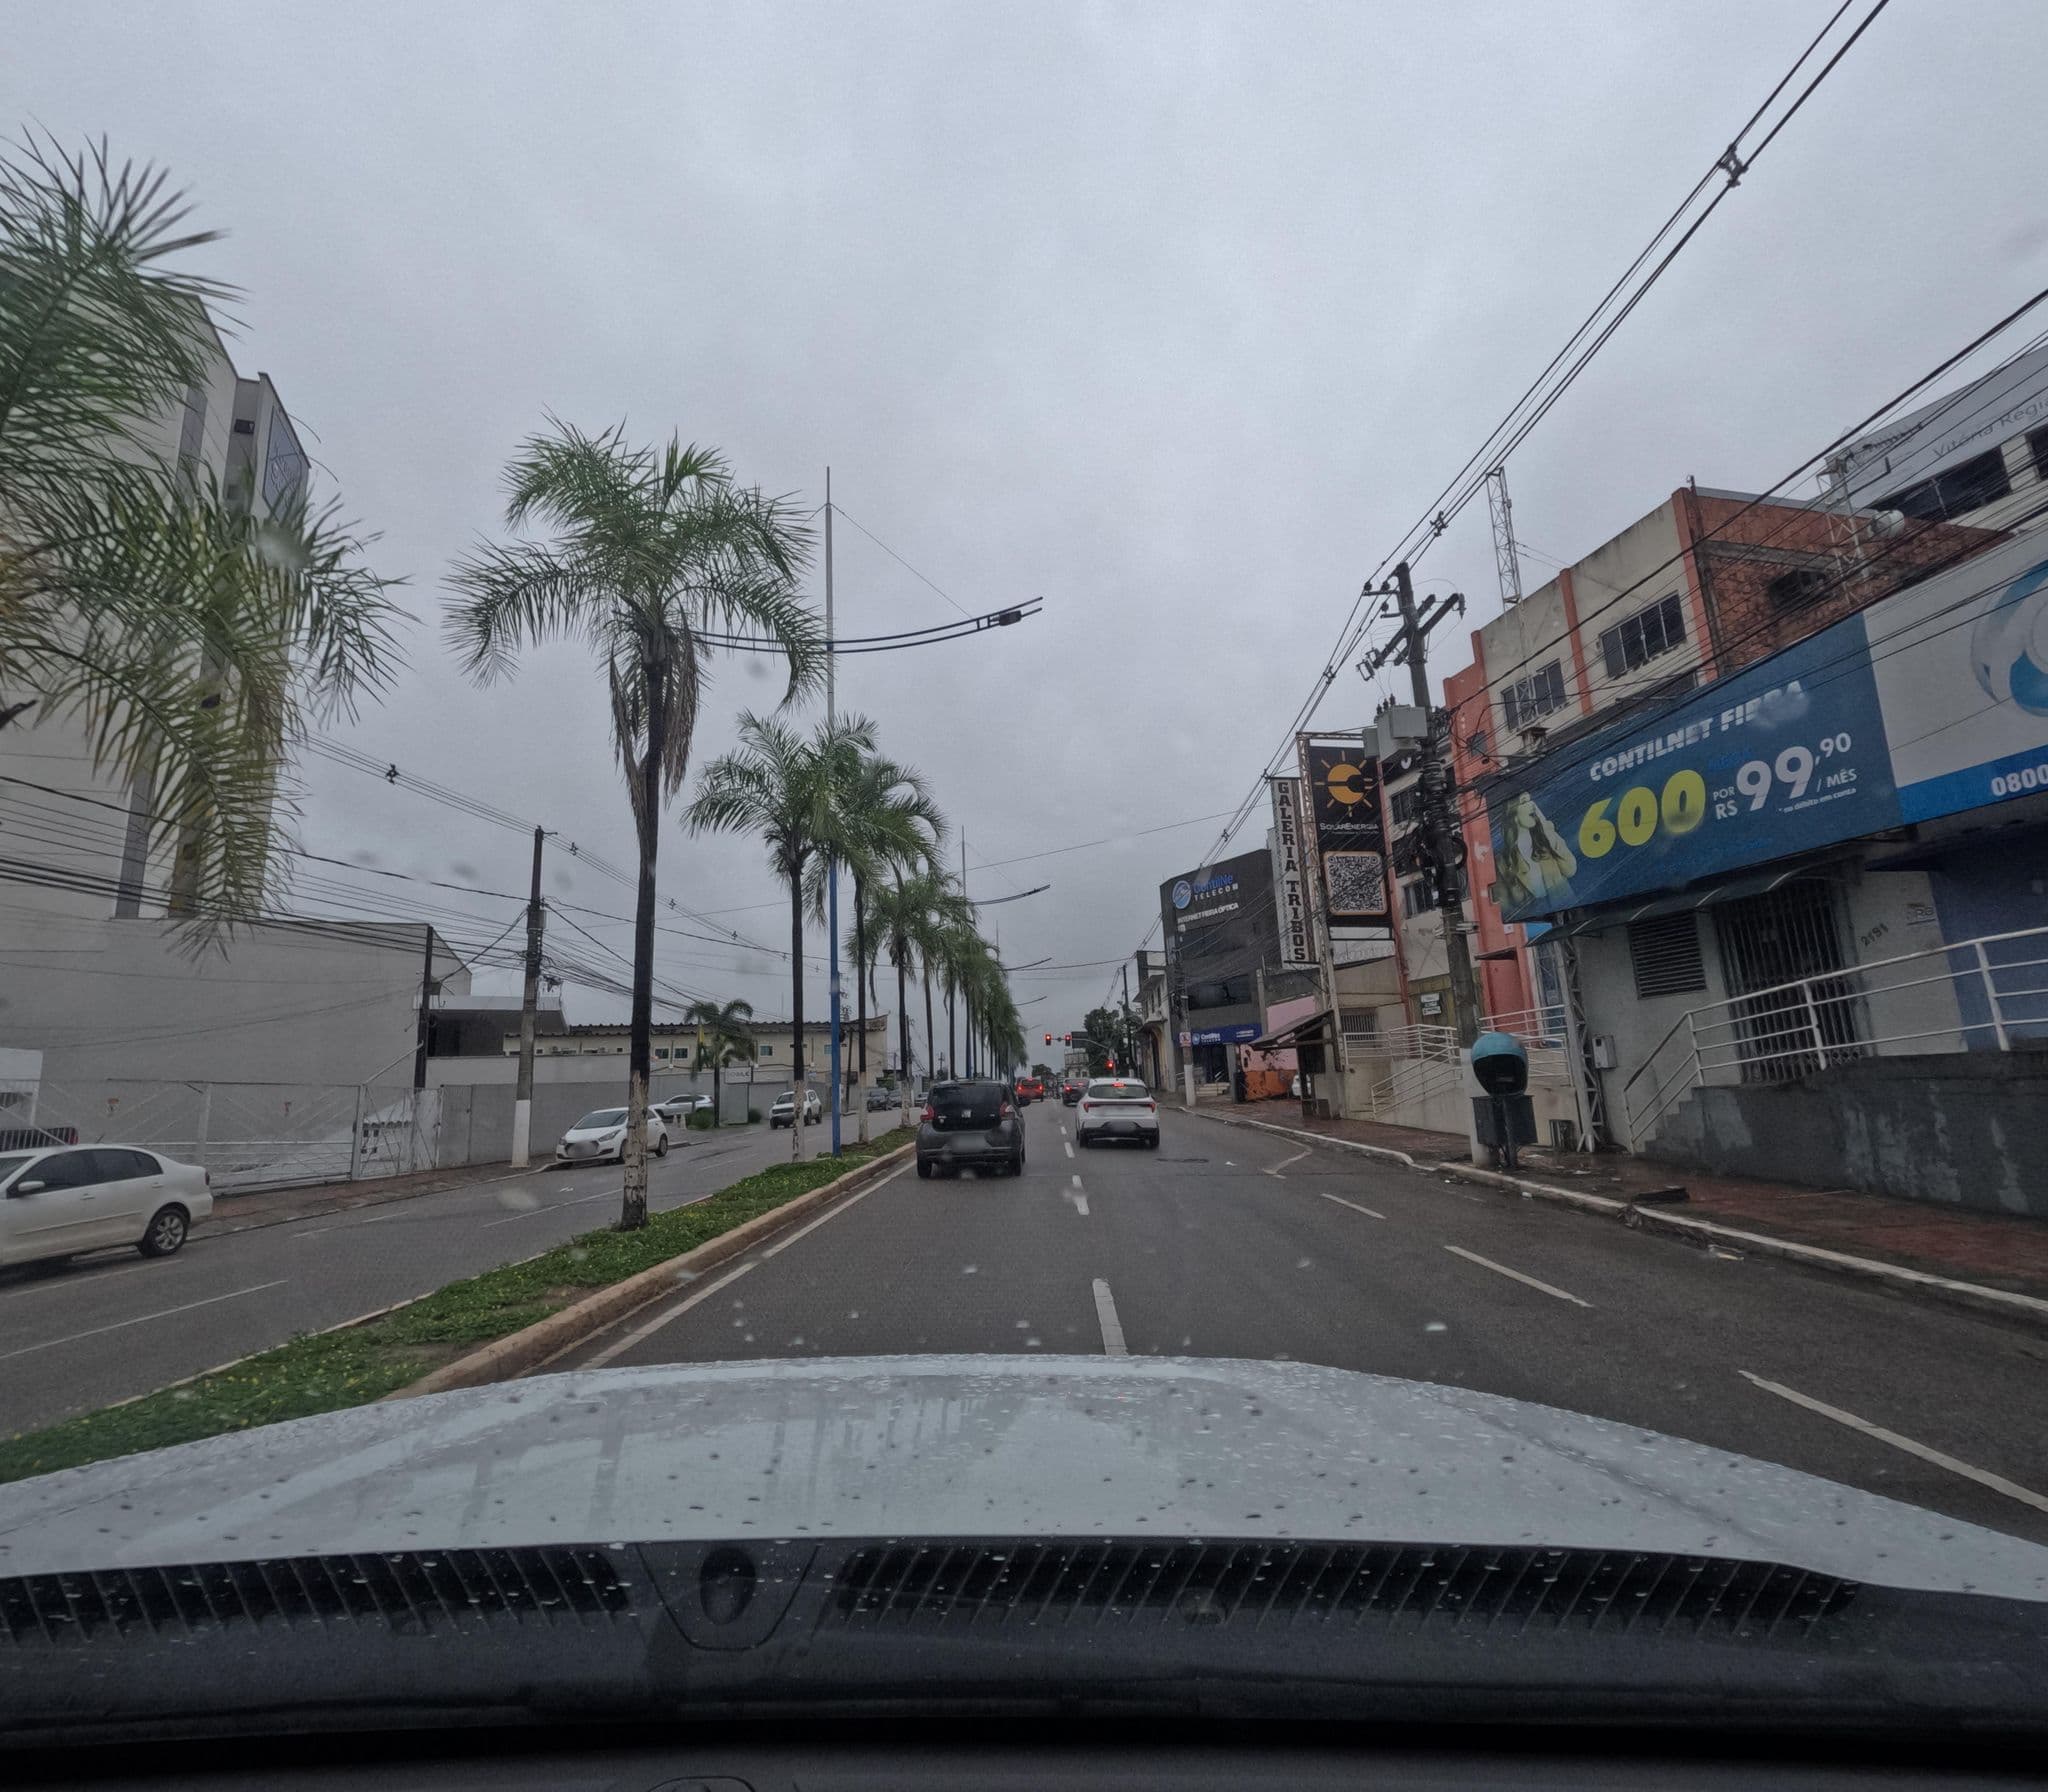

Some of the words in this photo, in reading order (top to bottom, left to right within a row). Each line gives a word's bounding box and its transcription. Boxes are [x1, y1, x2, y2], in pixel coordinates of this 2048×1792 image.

[1590, 718, 1713, 781] CONTILNET
[1578, 769, 1706, 859] 600
[1713, 786, 1735, 801] POR
[1278, 782, 1298, 872] GALERIA
[1194, 883, 1239, 901] TELECOM
